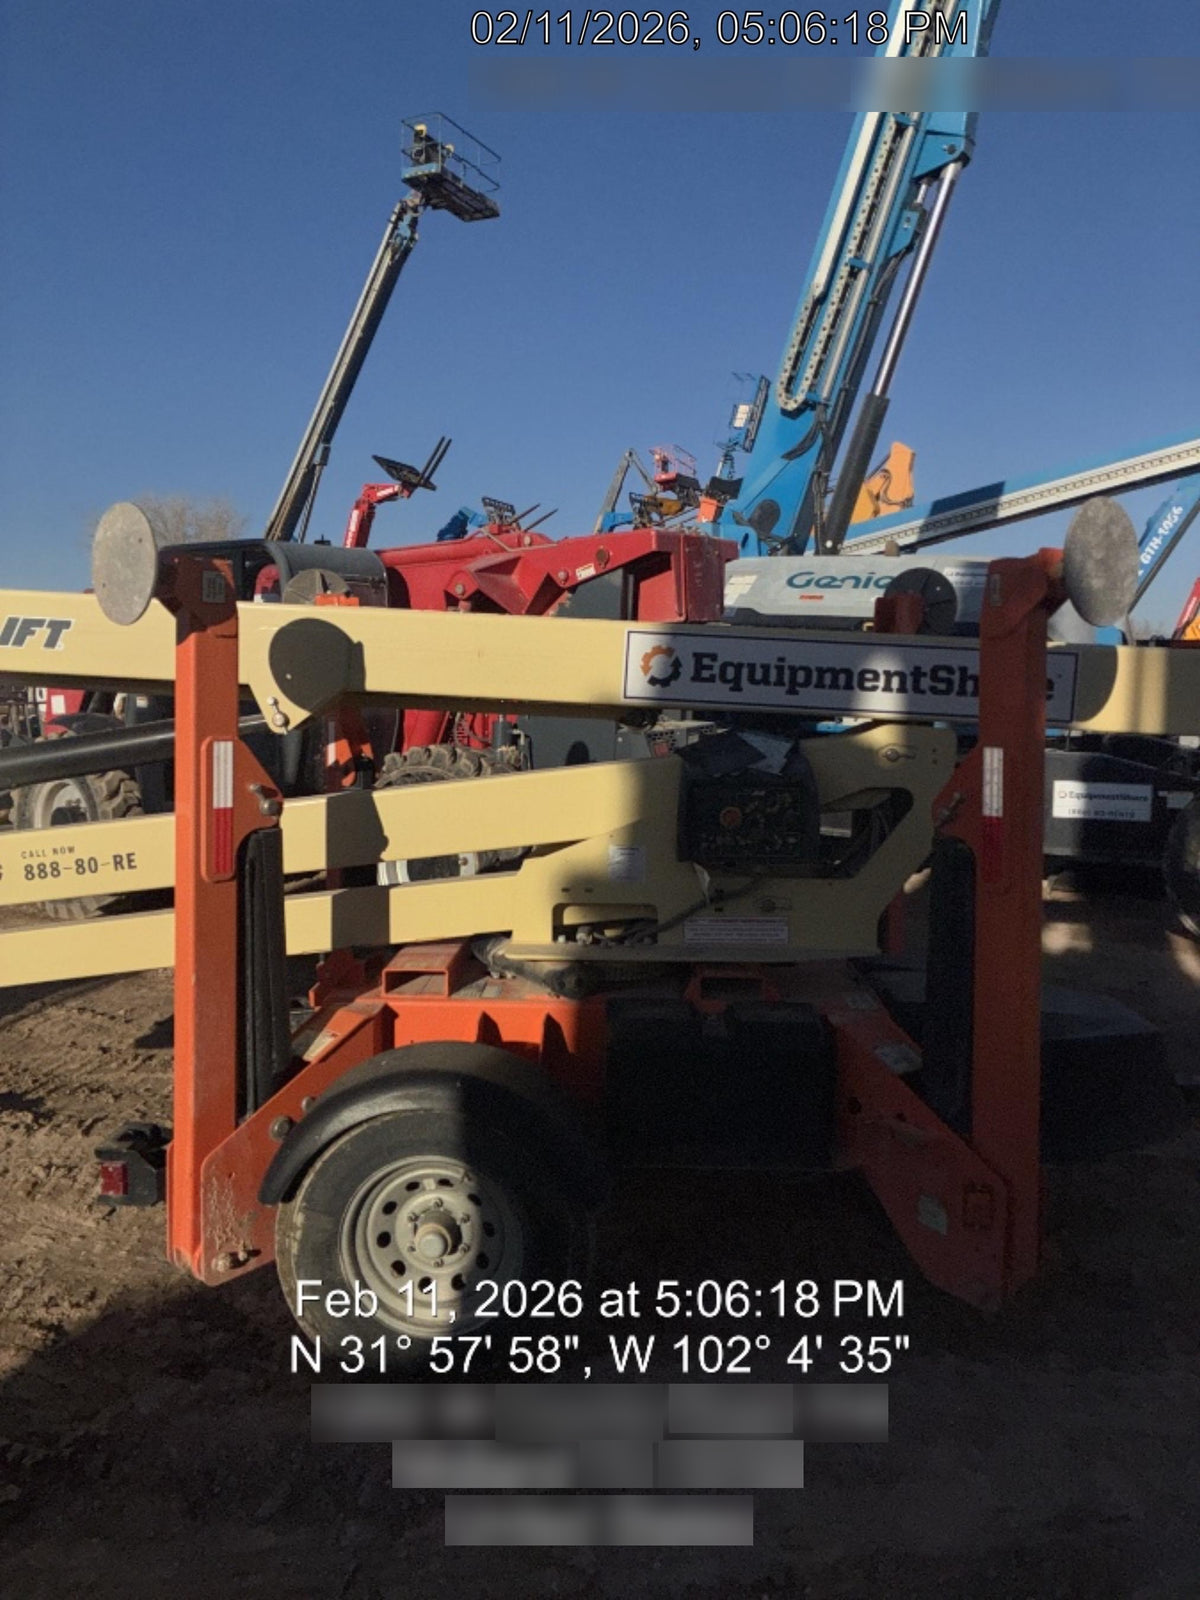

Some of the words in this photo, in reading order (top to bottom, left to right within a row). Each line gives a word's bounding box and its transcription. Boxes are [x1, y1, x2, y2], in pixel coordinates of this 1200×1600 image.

[0, 616, 73, 649] IFT
[690, 651, 1055, 701] EquipmentSh
[21, 849, 47, 860] CALL
[52, 845, 75, 856] NOW
[23, 852, 138, 881] 888-80-RE
